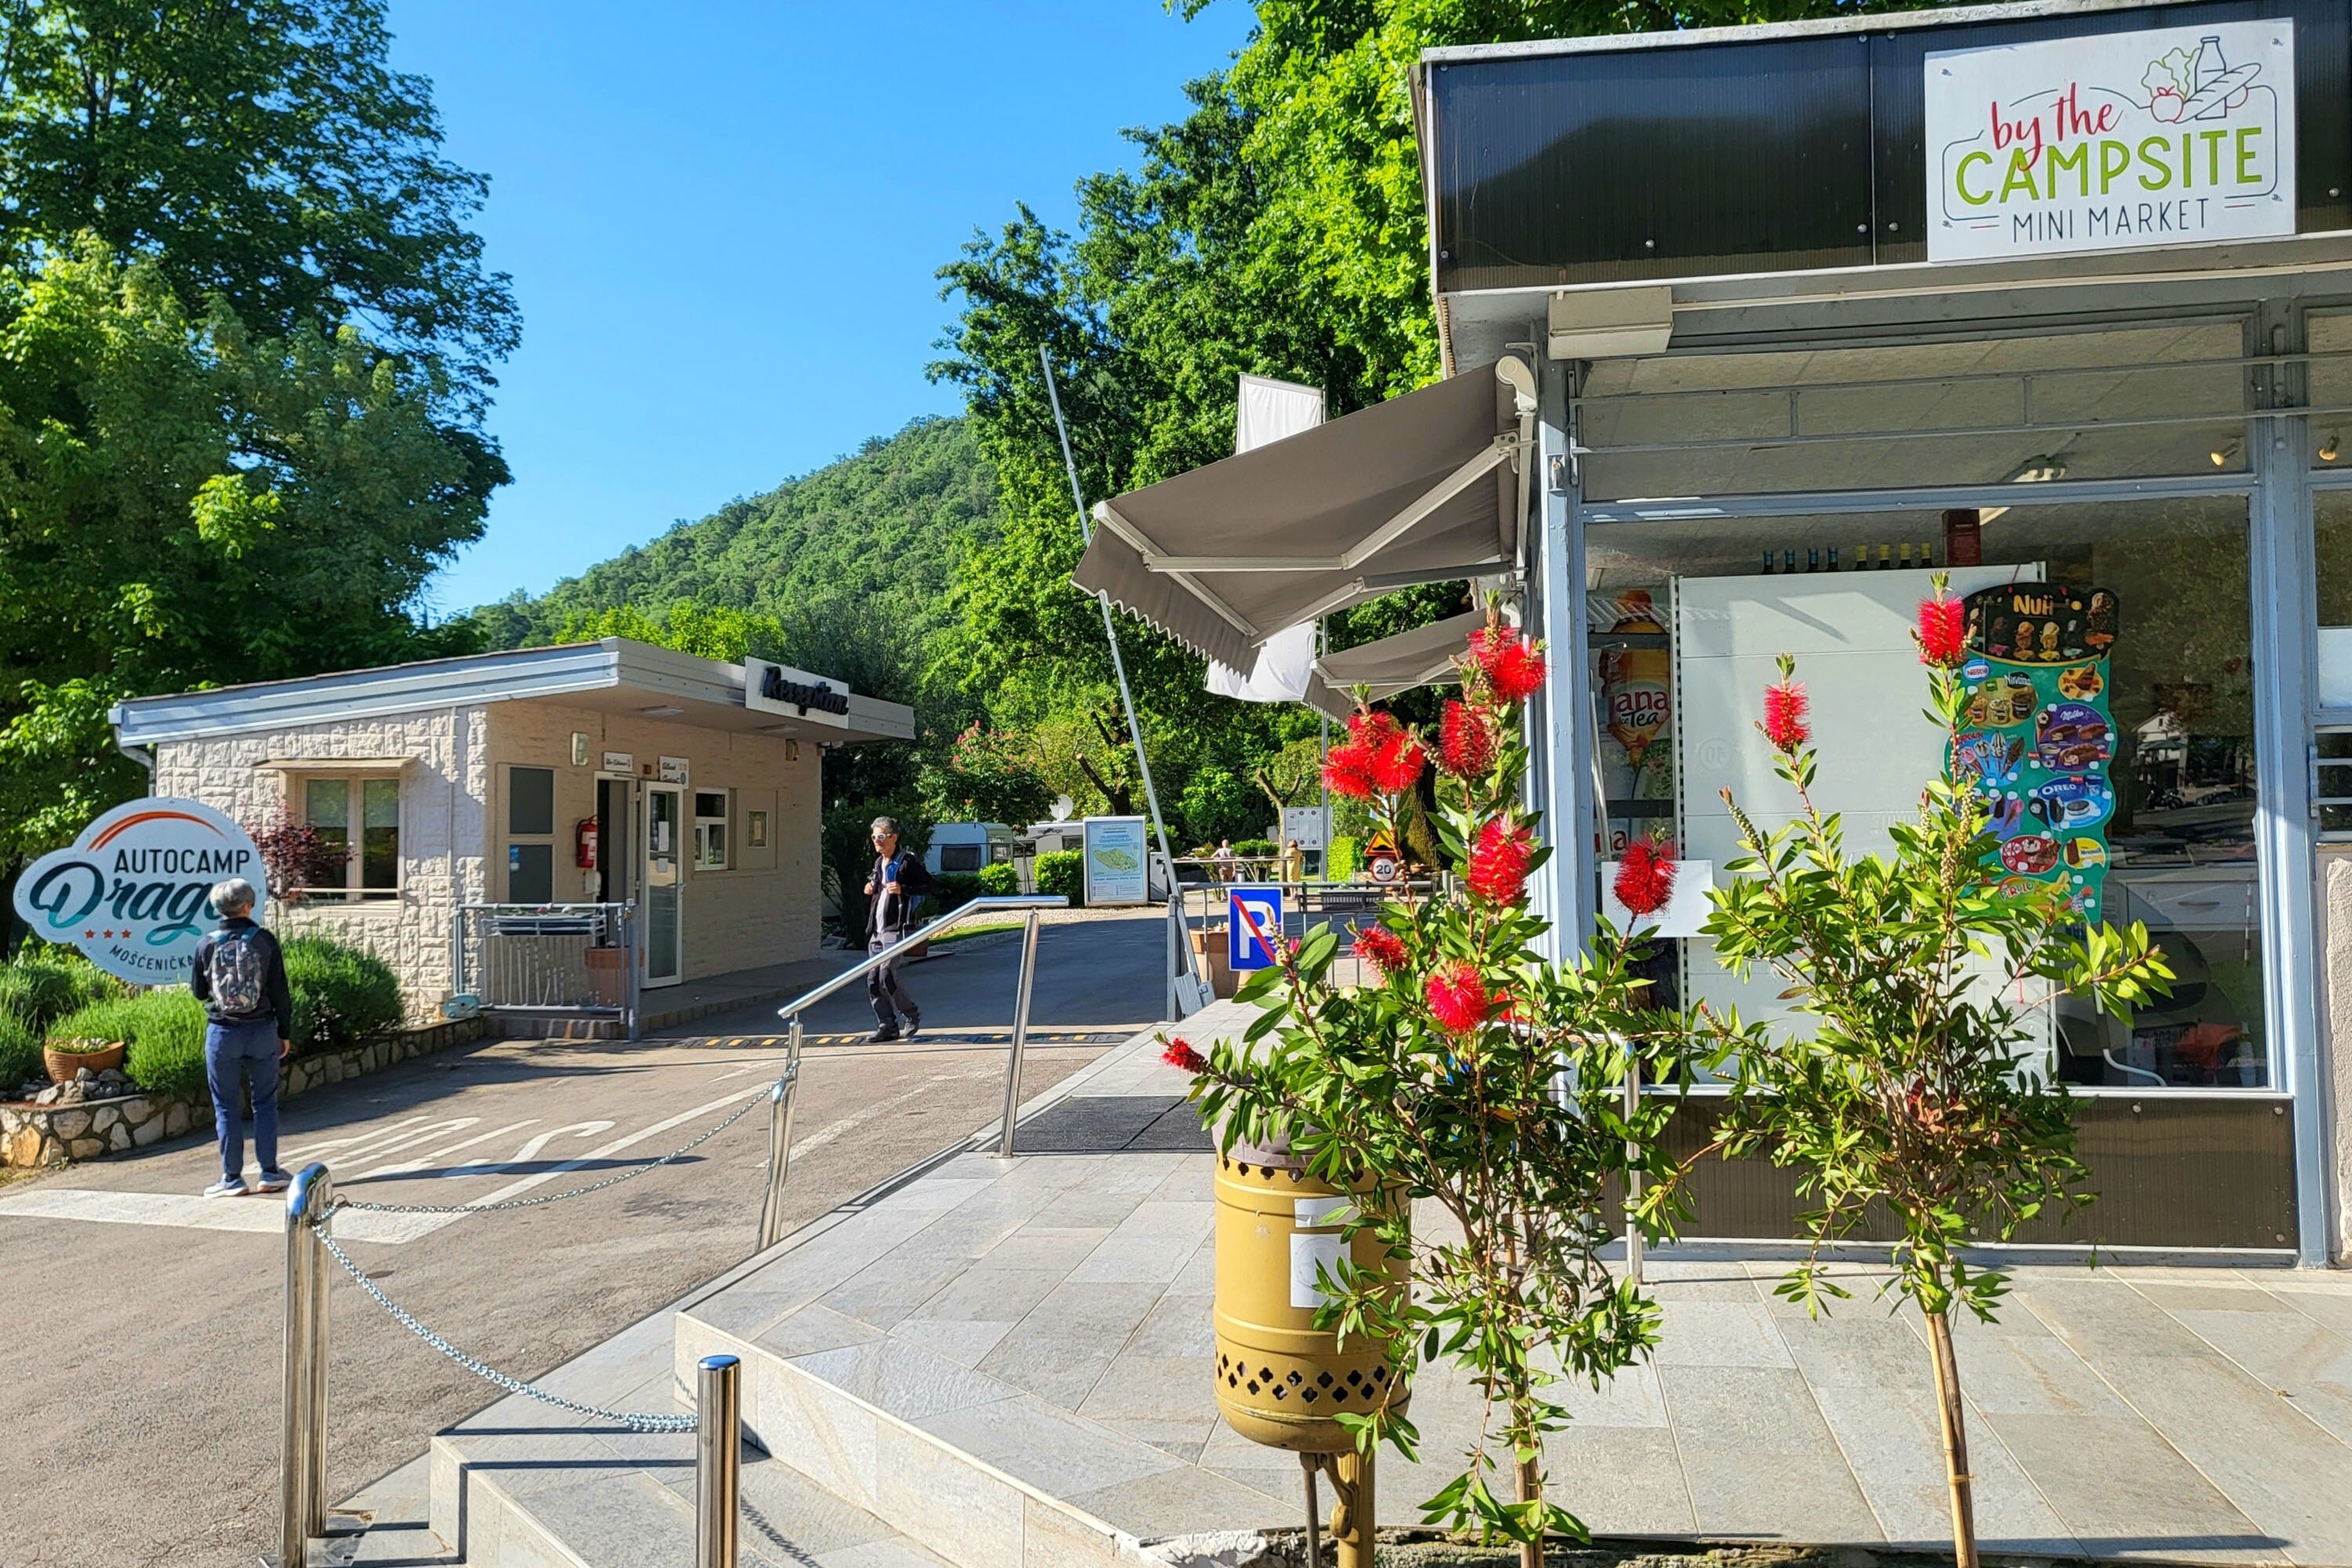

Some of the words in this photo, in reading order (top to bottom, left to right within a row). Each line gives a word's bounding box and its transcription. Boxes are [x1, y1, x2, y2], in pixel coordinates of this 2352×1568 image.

[1992, 101, 2045, 172] by
[2049, 82, 2123, 141] the
[1956, 127, 2262, 205] CAMPSITE
[2013, 209, 2073, 243] MINI
[2089, 198, 2209, 236] MARKET
[1622, 706, 1659, 728] Tea
[2042, 784, 2077, 795] OREO
[114, 849, 250, 873] AUTOCAMP
[1376, 865, 1391, 874] 20
[1998, 881, 2034, 902] PIRULO
